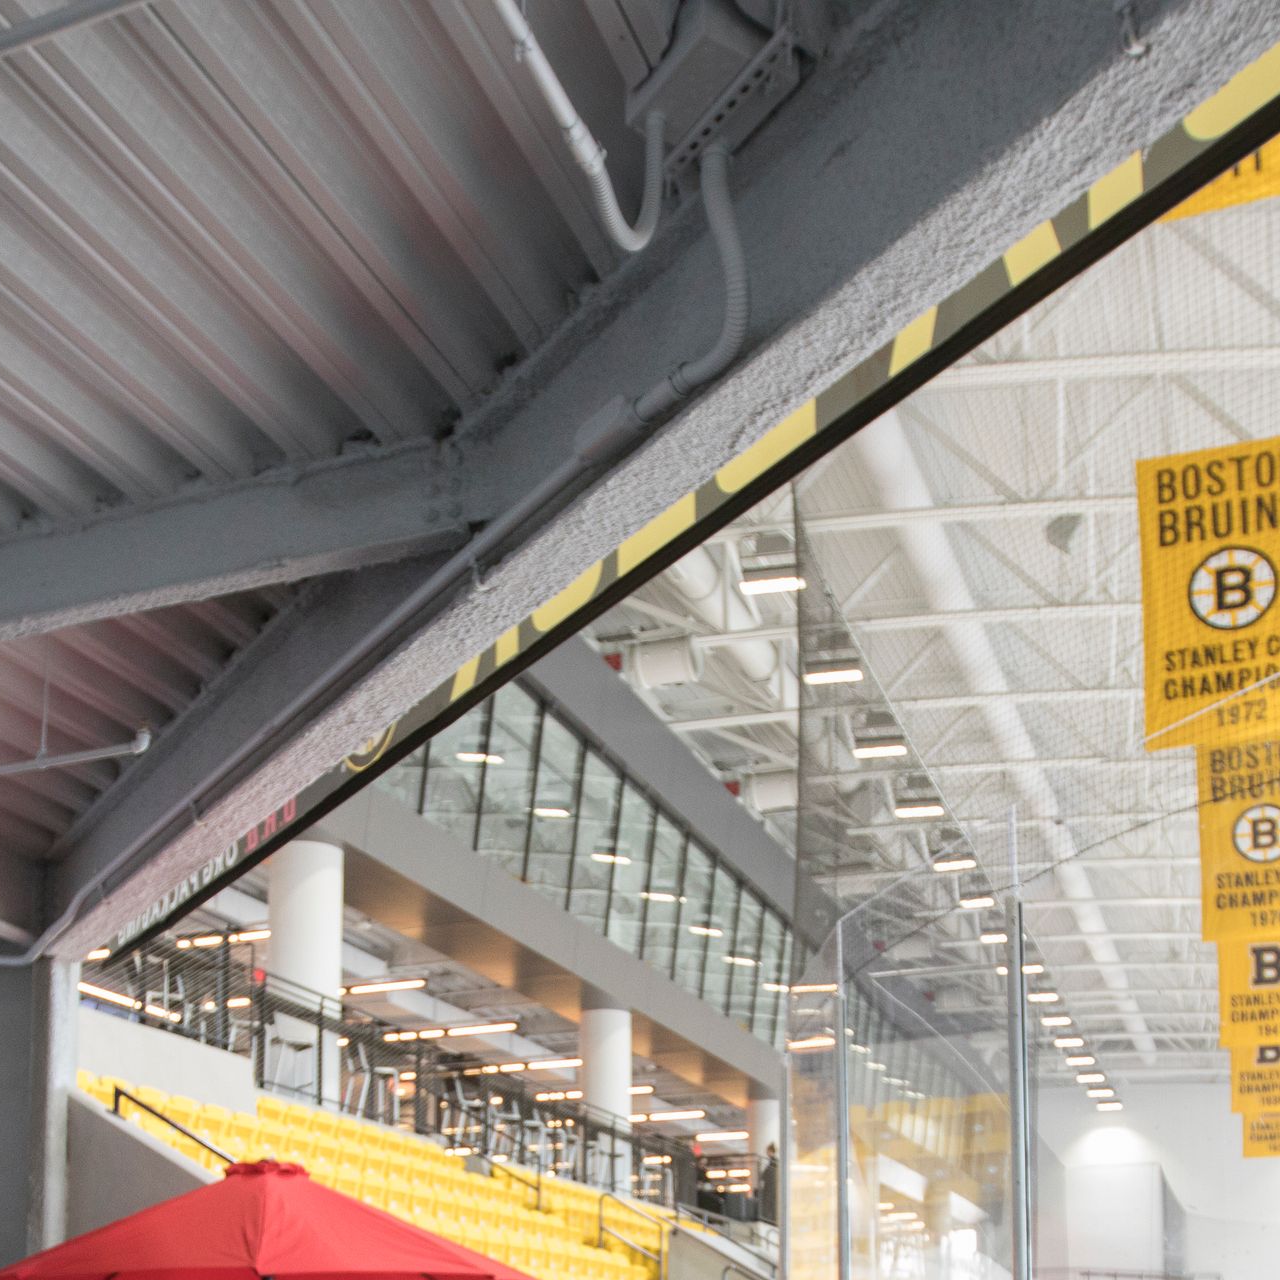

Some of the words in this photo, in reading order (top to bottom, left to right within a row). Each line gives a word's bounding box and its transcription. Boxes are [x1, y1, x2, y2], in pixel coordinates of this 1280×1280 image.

[1215, 566, 1253, 611] B
[1165, 637, 1260, 672] STANLEY
[1217, 699, 1269, 728] 1972
[1250, 817, 1278, 849] B
